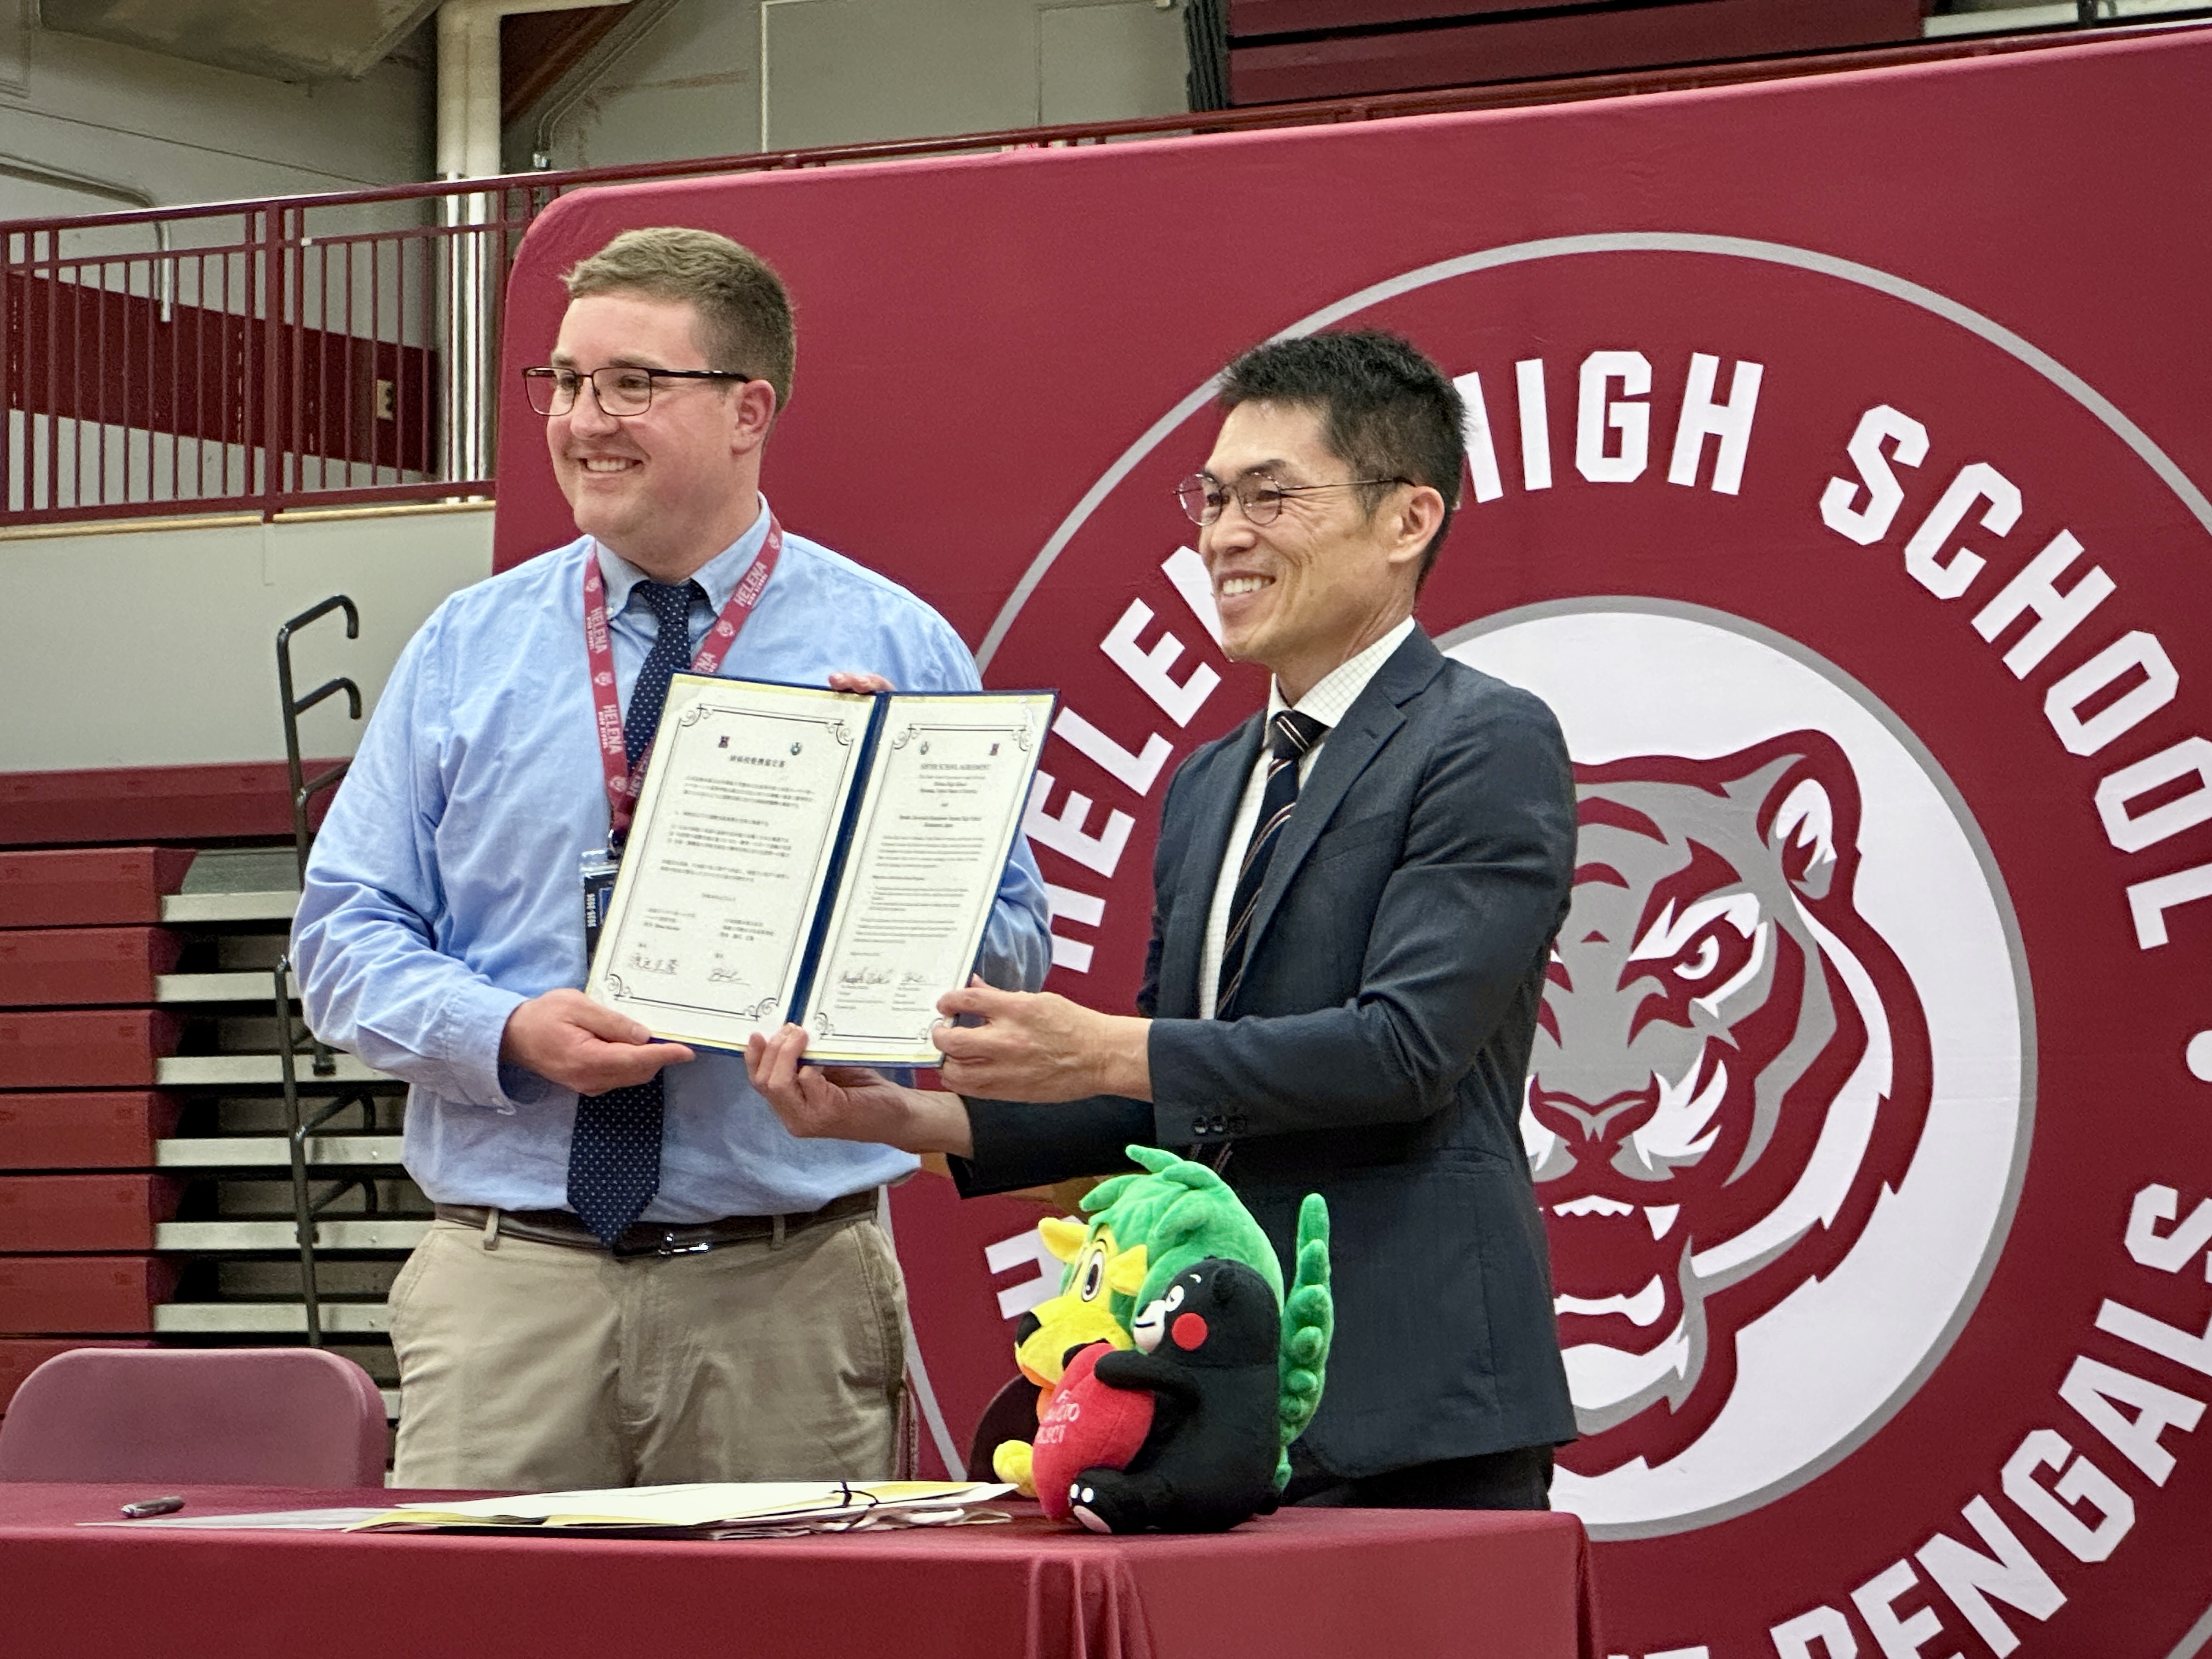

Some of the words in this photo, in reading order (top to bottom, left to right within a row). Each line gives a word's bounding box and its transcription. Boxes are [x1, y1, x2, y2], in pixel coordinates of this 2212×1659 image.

[733, 561, 768, 607] HELENA
[590, 606, 607, 654] HELENA
[1022, 546, 1233, 973] ELE
[1819, 404, 2212, 950] SCHOOL
[603, 704, 623, 754] HELENA
